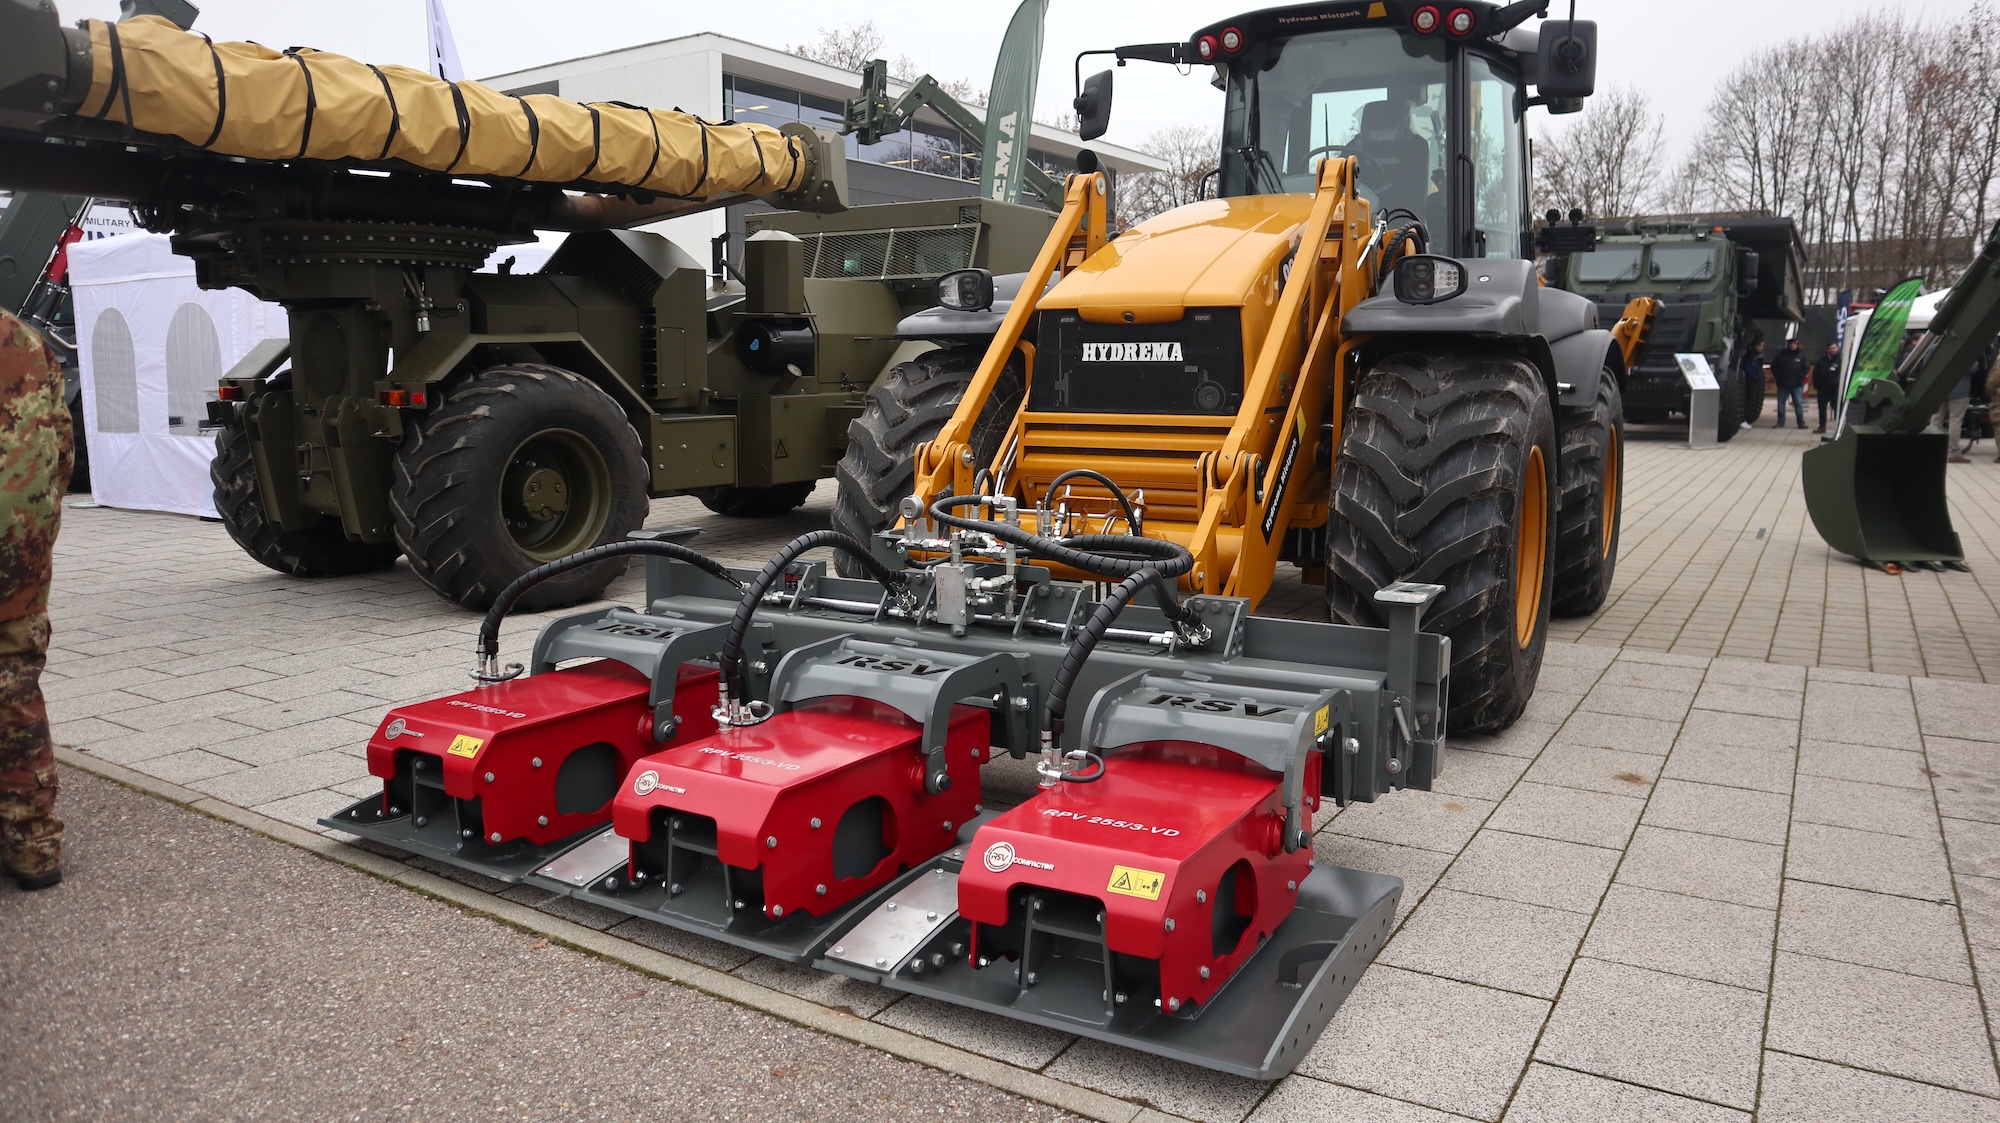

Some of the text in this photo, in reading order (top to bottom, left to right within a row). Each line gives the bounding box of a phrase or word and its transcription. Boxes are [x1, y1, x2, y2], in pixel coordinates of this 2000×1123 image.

[1278, 10, 1361, 24] Hydrema Mietpark
[86, 217, 130, 228] MILITARY
[1082, 342, 1183, 361] HYDREMA
[836, 655, 950, 676] RSV
[446, 699, 477, 710] RPV
[1147, 694, 1289, 717] RSV
[699, 746, 801, 771] RPV 255/3-VD
[655, 782, 687, 795] COMPACTOR
[1043, 808, 1181, 838] RPV 255/3-VD
[990, 852, 1056, 871] RSV COMPACTOR
